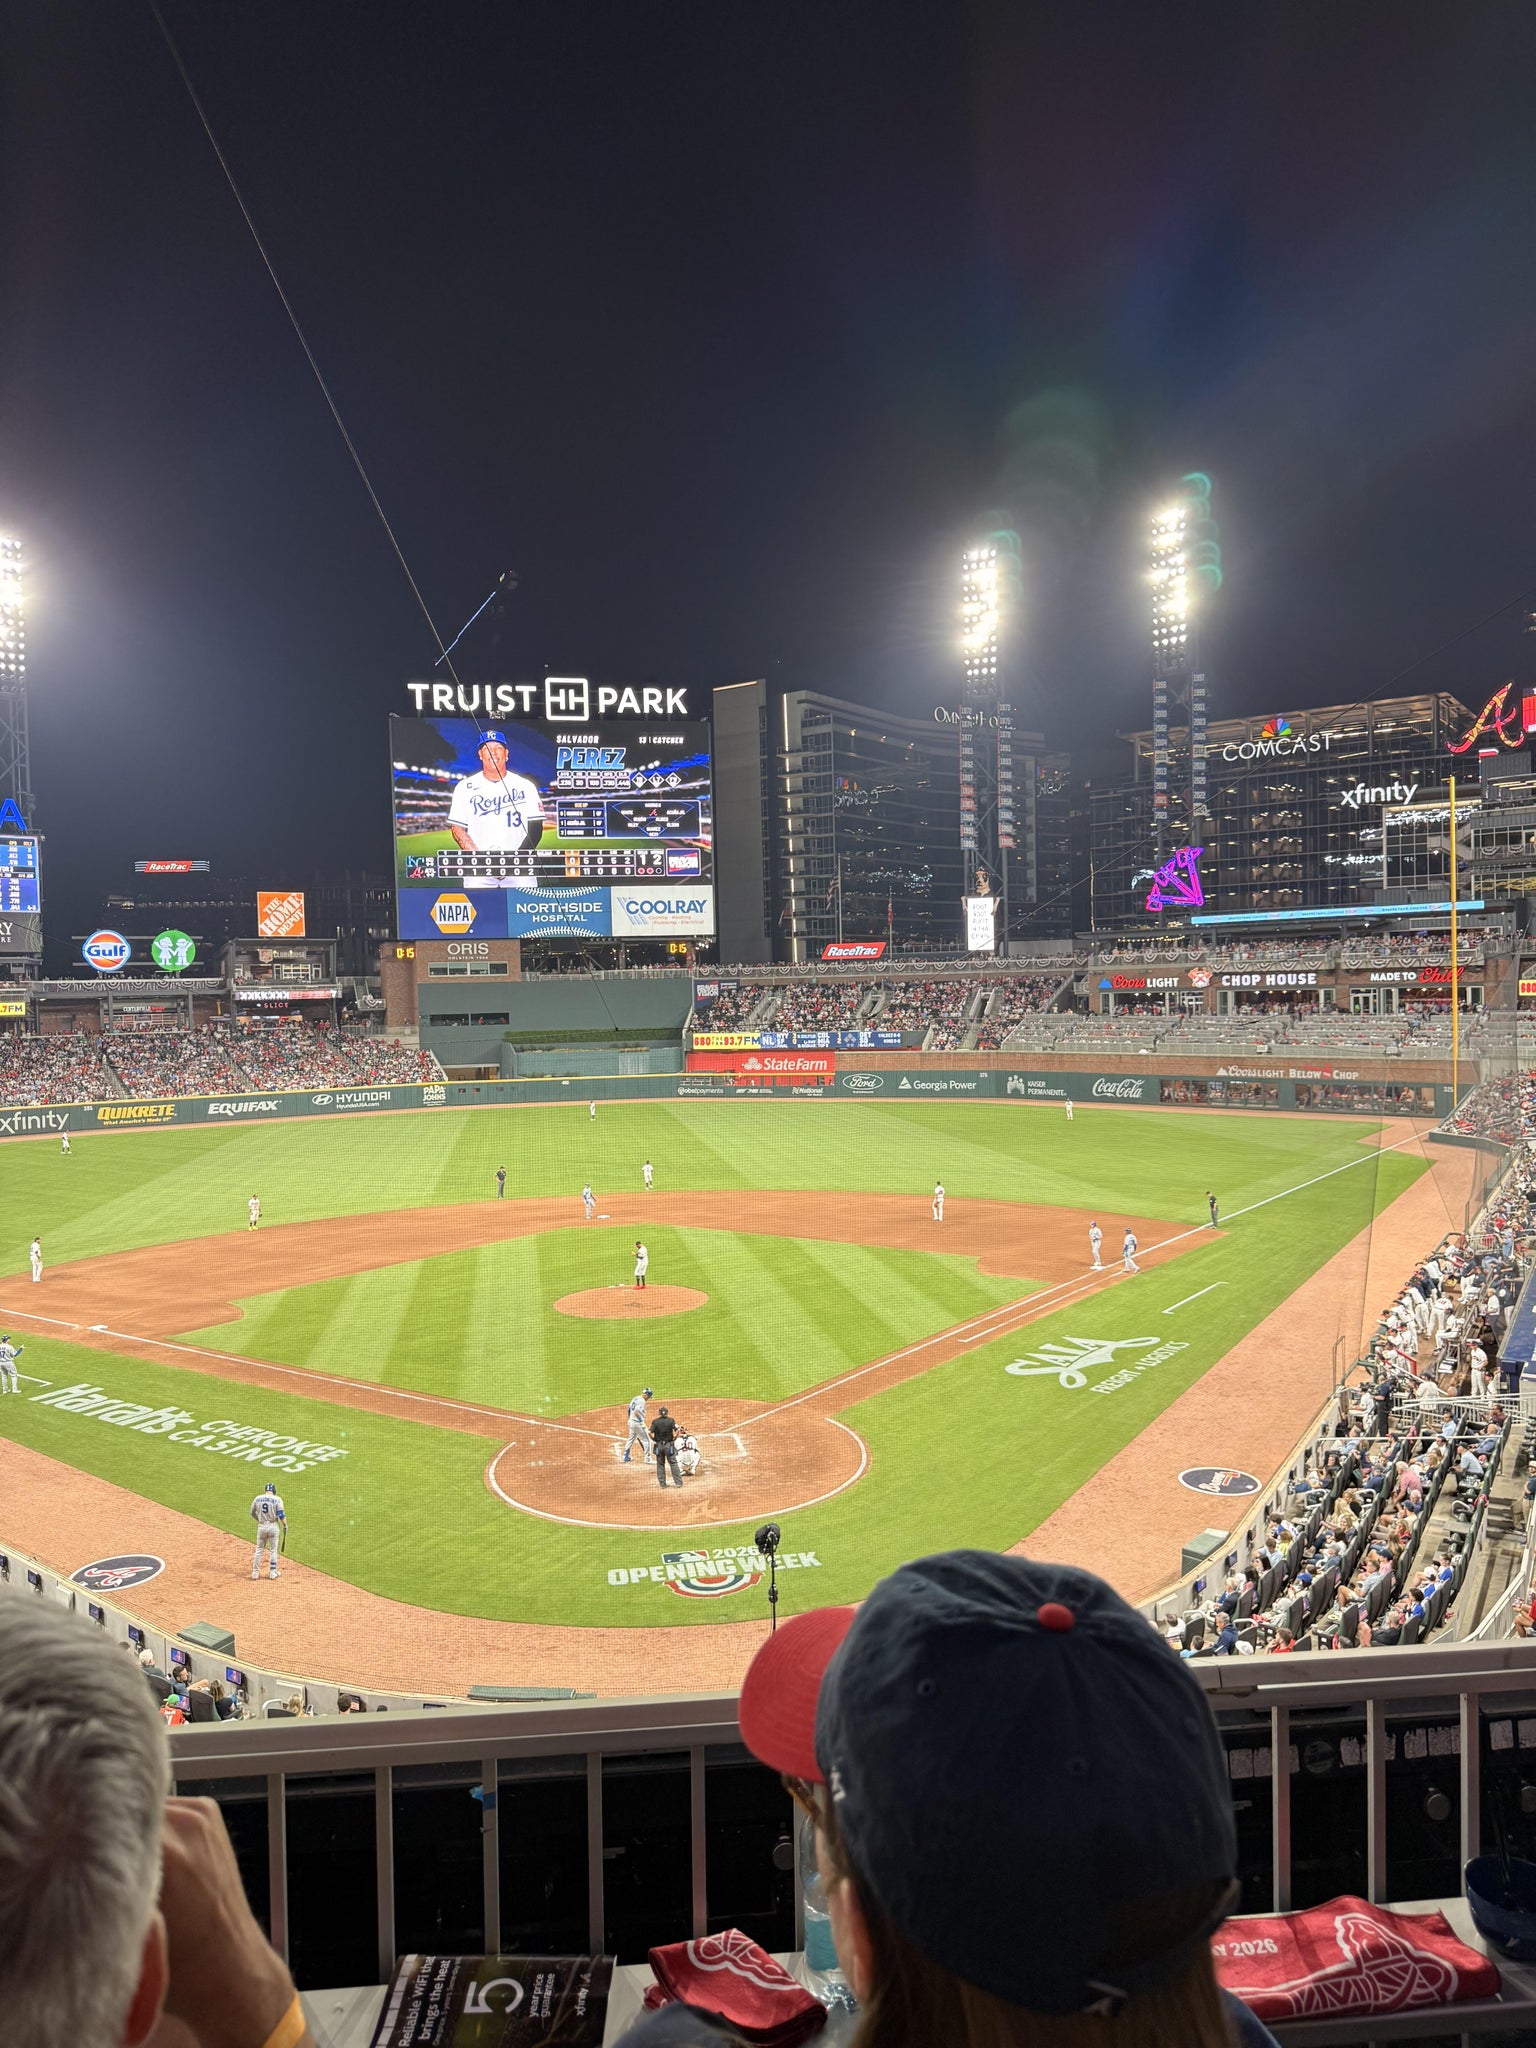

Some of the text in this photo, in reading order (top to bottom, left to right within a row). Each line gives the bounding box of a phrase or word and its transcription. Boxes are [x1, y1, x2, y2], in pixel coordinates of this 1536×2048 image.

[407, 683, 688, 714] TRUIST PARK
[556, 735, 599, 744] SALVADOR
[1222, 734, 1332, 761] COMCAST
[556, 747, 626, 769] PEREZ
[470, 788, 526, 816] Royals
[1341, 781, 1419, 809] xfinity
[506, 810, 521, 827] 13
[653, 854, 662, 865] 2
[263, 896, 282, 914] THE
[516, 902, 602, 913] NORTHSIDE
[626, 899, 707, 915] COOLRAY
[259, 893, 303, 935] HOME
[439, 905, 469, 922] NAPA
[533, 914, 587, 923] HOSPITAL
[87, 945, 126, 957] Gulf
[447, 943, 489, 955] ORIS
[827, 945, 878, 957] RaceTrac
[1112, 975, 1179, 989] Coors LIGHT
[1221, 973, 1317, 987] CHOP HOUSE
[1370, 972, 1400, 981] MADE
[1402, 972, 1417, 980] TO
[8, 1005, 22, 1013] FM
[694, 1036, 711, 1046] 680
[724, 1036, 743, 1046] 93.7
[744, 1037, 760, 1045] FM
[1228, 1065, 1359, 1080] Coors LIGHT BELOW CHOP
[850, 1075, 876, 1088] Ford
[913, 1080, 976, 1090] Georgia Power
[1092, 1078, 1146, 1099] Coca-Cola
[336, 1091, 391, 1103] HYUNDAI
[423, 1086, 445, 1094] PAPA
[1028, 1087, 1064, 1096] PERMANENTE
[97, 1104, 177, 1120] QUIKRETE
[208, 1101, 279, 1116] EQUIFAX
[336, 1102, 380, 1110] HyundaiUSA.com
[0, 1111, 69, 1134] xfinity
[1089, 1368, 1141, 1394] FREIGHT
[200, 1419, 351, 1462] CHEROKEE
[168, 1429, 318, 1474] CASINOS
[262, 1503, 269, 1514] 9
[712, 1545, 760, 1558] 2026
[607, 1551, 822, 1586] OPENING WEEK
[1229, 1938, 1279, 1957] 2026
[398, 1956, 436, 2047] Reliable WiFi that
[418, 1960, 451, 2040] brings the heat
[463, 1978, 524, 2014] 5
[529, 1973, 544, 2018] year price
[540, 1973, 555, 2018] guarantee
[575, 1987, 589, 2016] xfinity
